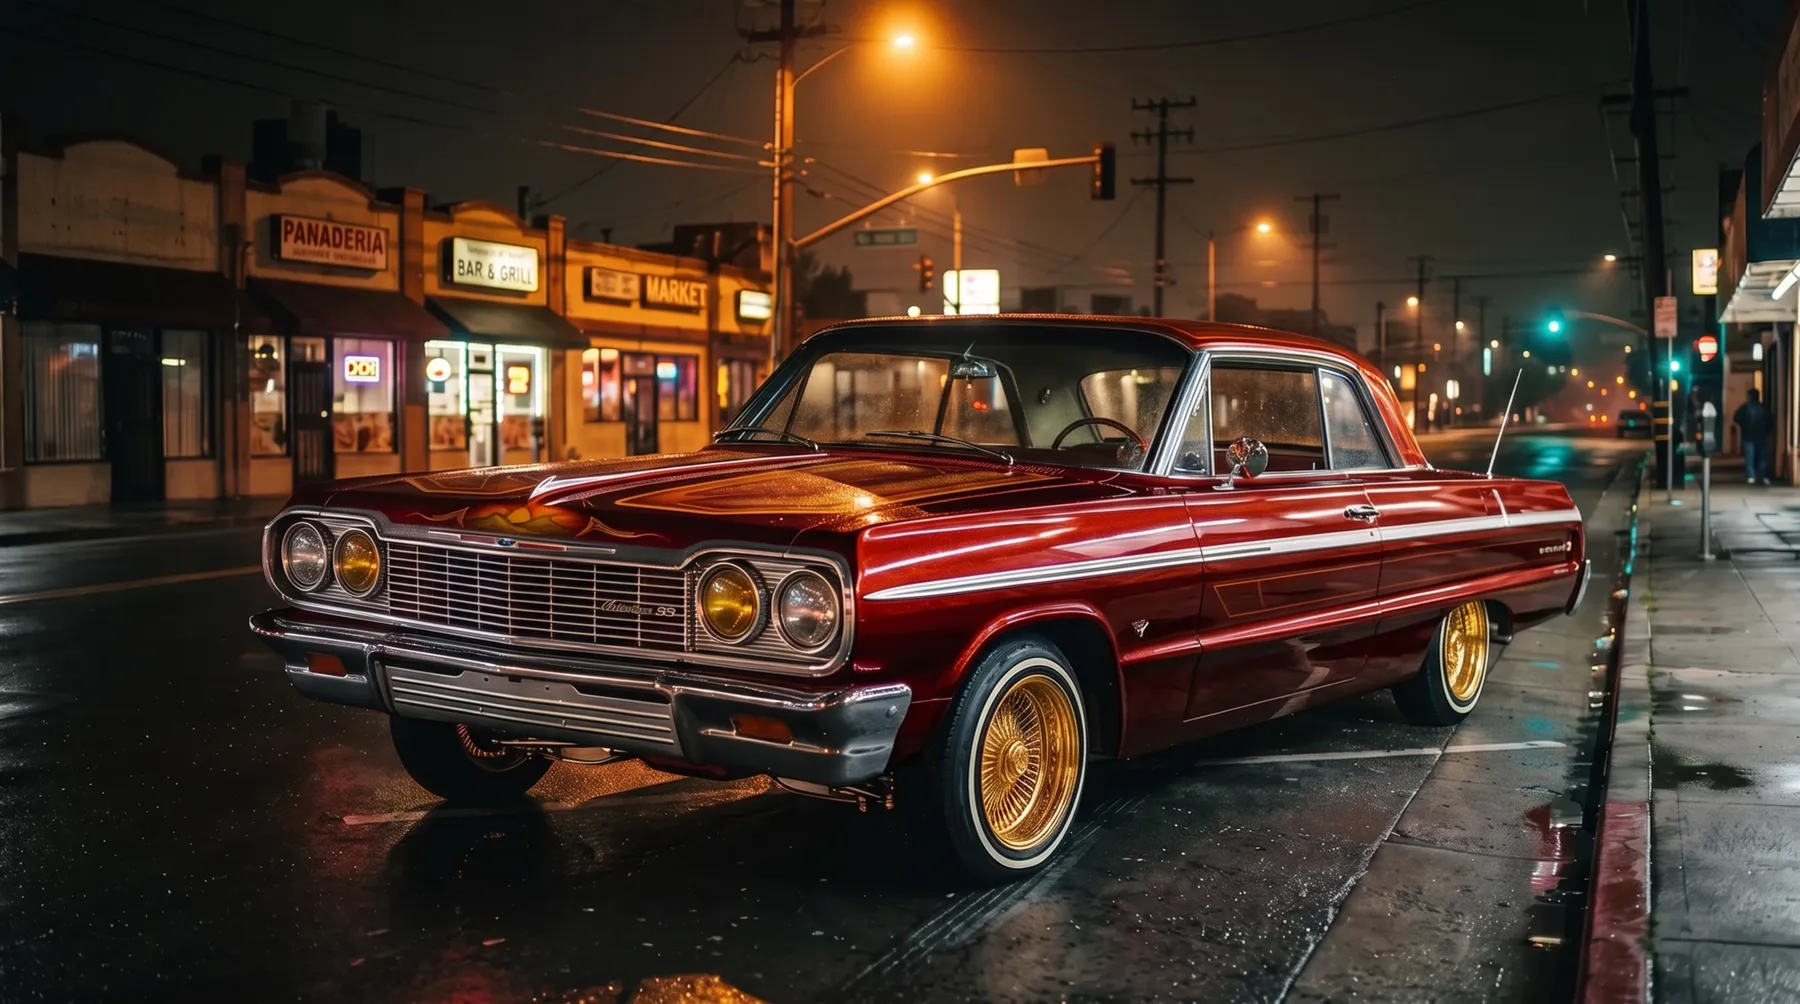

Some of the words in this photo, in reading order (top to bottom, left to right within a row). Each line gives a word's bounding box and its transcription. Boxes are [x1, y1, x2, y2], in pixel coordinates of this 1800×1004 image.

[284, 219, 383, 255] PANADERIA
[458, 260, 483, 278] BAR
[488, 263, 495, 280] &
[500, 265, 532, 285] GRILL
[646, 275, 707, 307] MARKET
